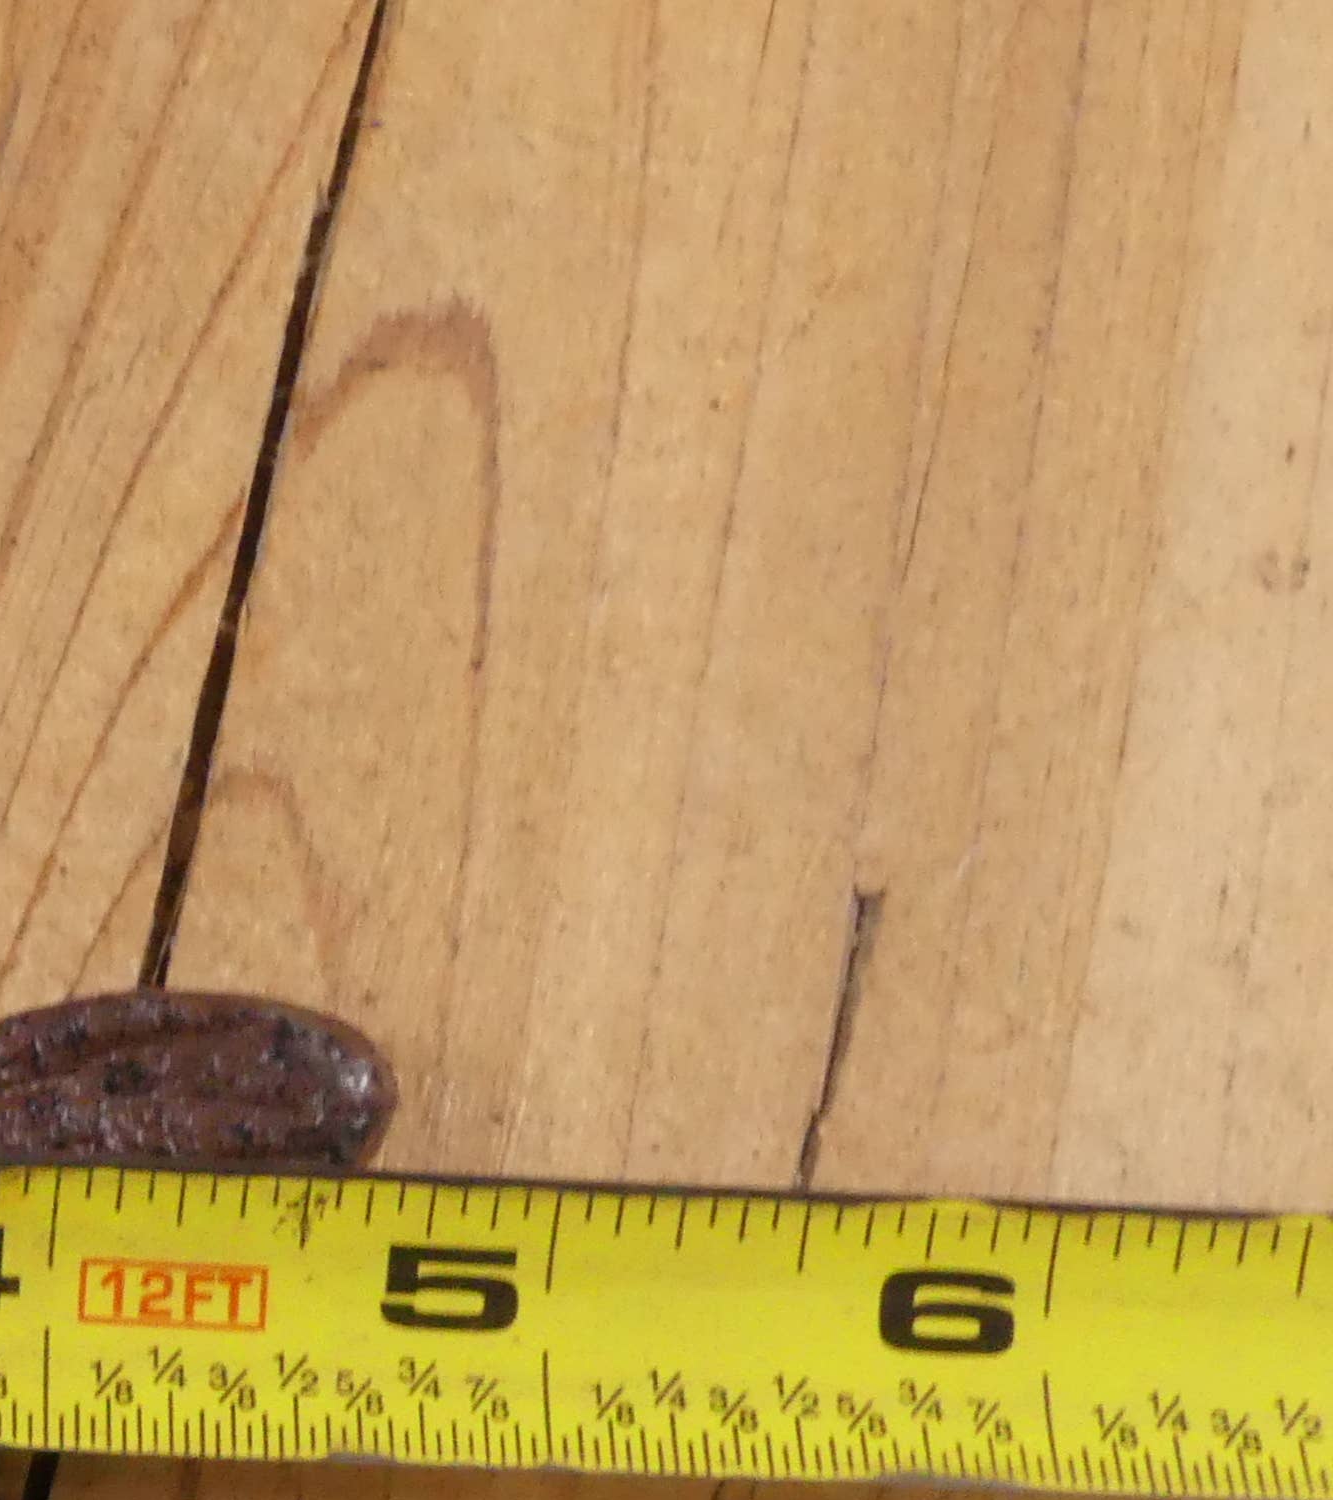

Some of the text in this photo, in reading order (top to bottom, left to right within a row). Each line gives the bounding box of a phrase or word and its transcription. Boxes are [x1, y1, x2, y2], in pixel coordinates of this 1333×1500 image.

[101, 1268, 255, 1324] 12FT
[380, 1244, 519, 1331] 5
[879, 1269, 1015, 1355] 6
